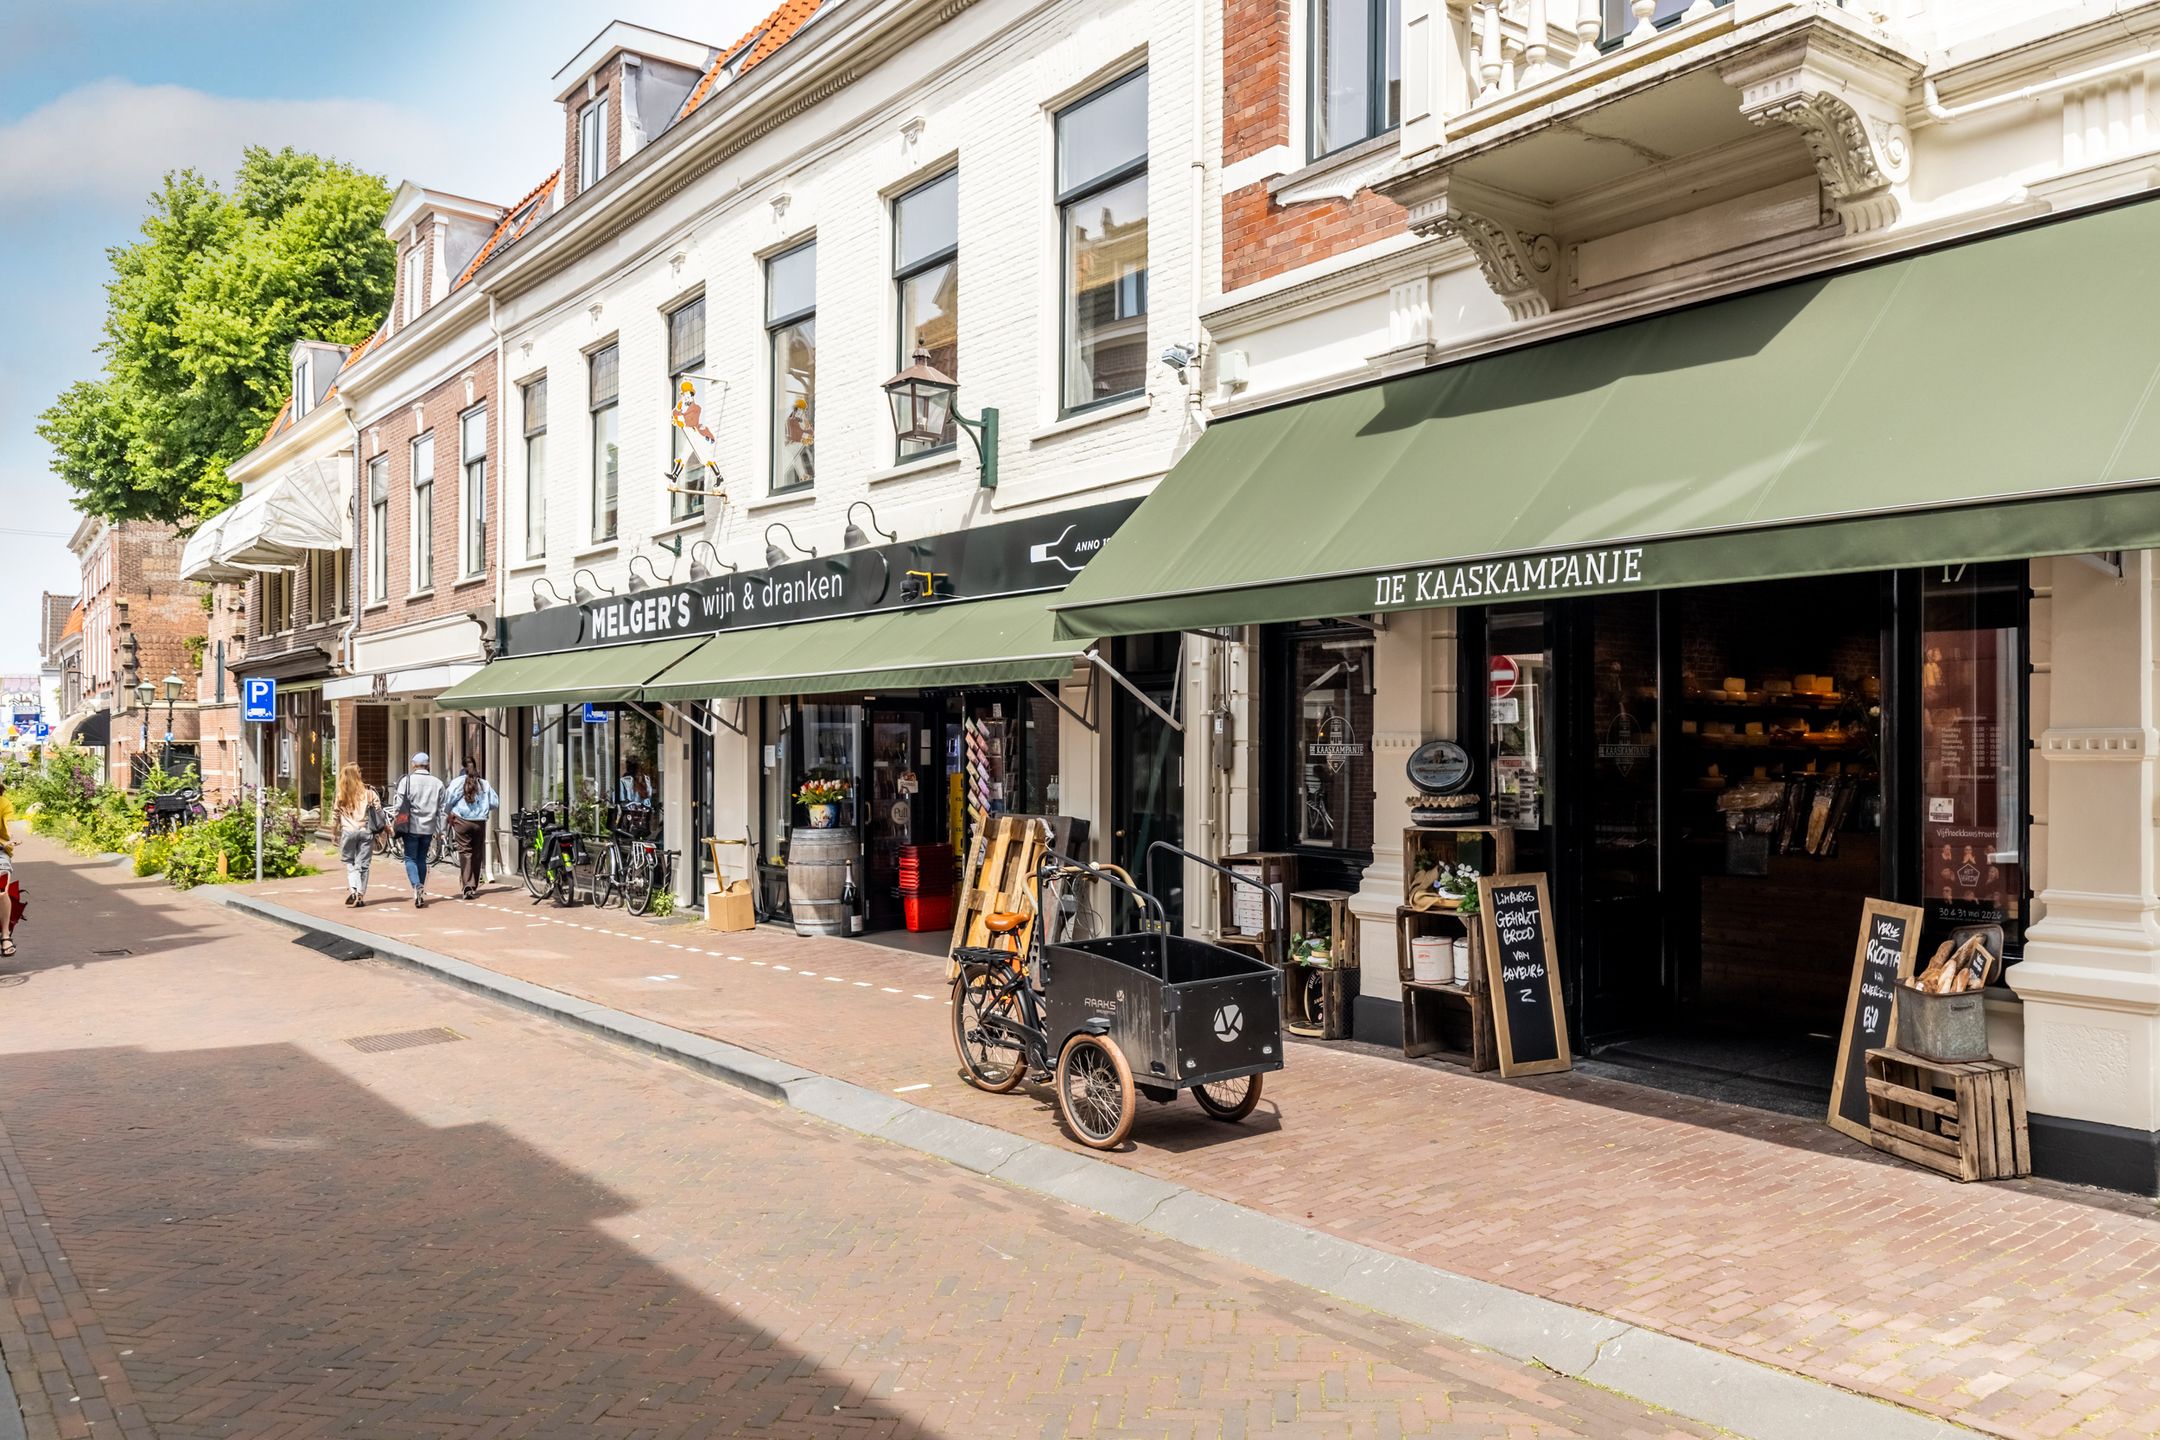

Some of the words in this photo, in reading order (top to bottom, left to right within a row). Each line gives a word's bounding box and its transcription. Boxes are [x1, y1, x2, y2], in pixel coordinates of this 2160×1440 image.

[1075, 539, 1100, 552] ANNO
[1375, 574, 1406, 606] DE
[1416, 548, 1643, 602] KAASKAMPANJE
[592, 592, 691, 639] MELGER'S
[702, 586, 735, 619] wijn
[742, 582, 755, 609] &
[762, 571, 842, 608] dranken
[252, 681, 269, 703] P
[38, 725, 46, 734] P
[1316, 745, 1364, 754] KAASKAMPANJE
[1940, 907, 1949, 916] 30
[1957, 908, 1966, 917] 31
[1503, 927, 1535, 945] BROOD
[1513, 950, 1530, 961] VAN
